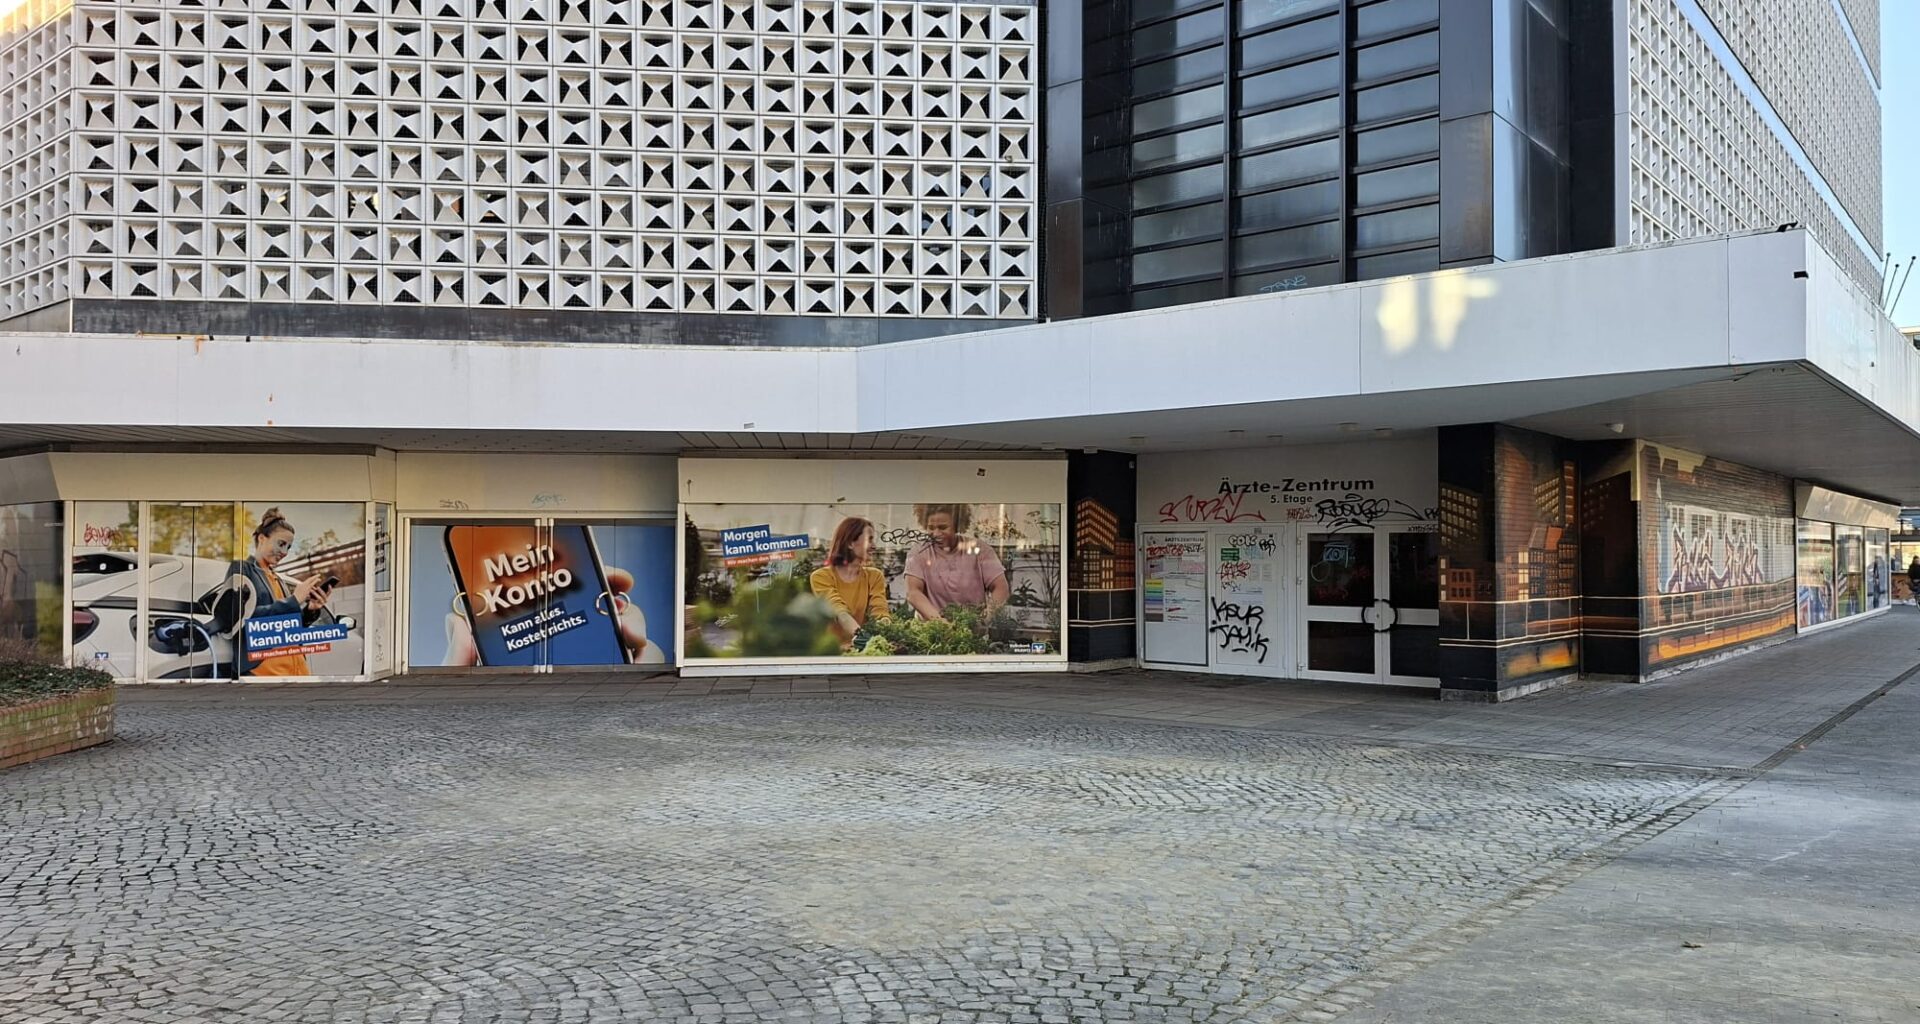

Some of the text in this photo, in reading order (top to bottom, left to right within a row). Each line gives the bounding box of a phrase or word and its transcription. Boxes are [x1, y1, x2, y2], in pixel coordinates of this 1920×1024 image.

[1218, 477, 1375, 494] Ärzte-Zentrum
[1270, 494, 1313, 505] 5. Etage
[724, 529, 768, 542] Morgen
[725, 538, 807, 556] kann kommen.
[484, 543, 555, 583] Mein
[484, 568, 572, 613] Konto
[249, 619, 299, 633] Morgen
[501, 607, 565, 637] Kann alles.
[250, 628, 345, 647] kann kommen.
[506, 629, 547, 652] Kostet
[263, 649, 288, 658] machen
[288, 647, 301, 655] den
